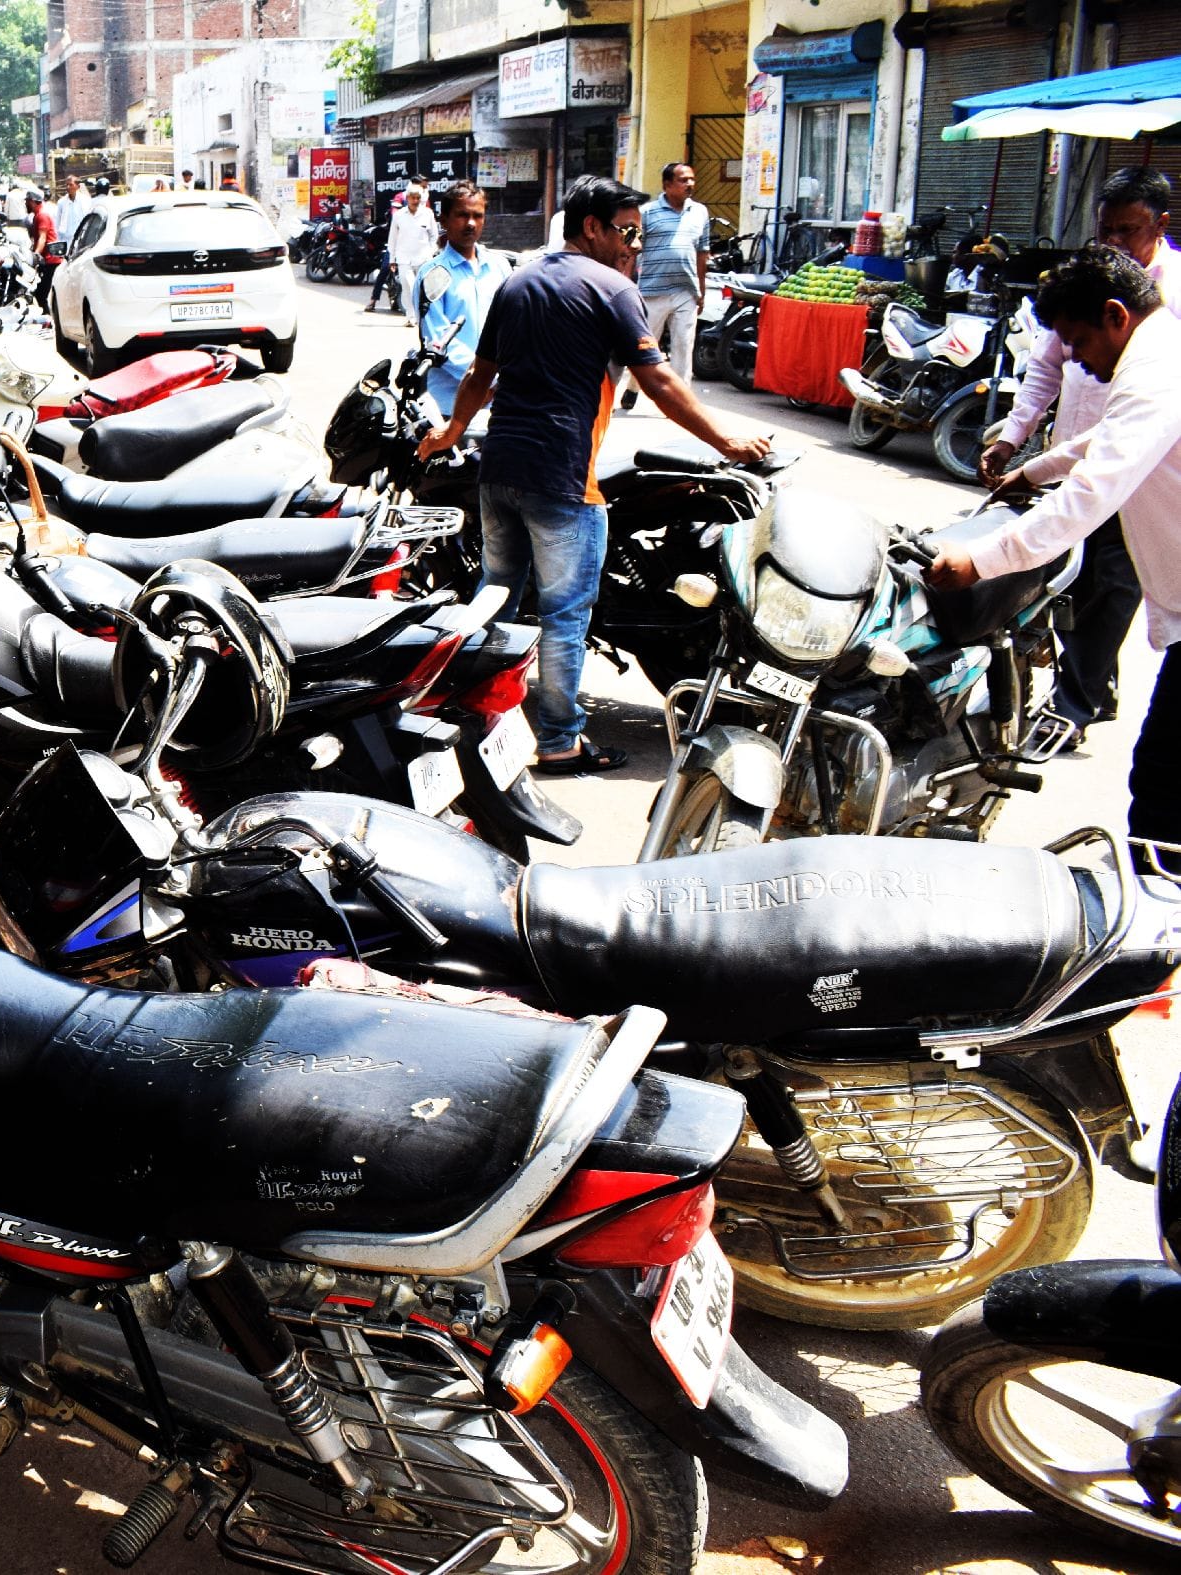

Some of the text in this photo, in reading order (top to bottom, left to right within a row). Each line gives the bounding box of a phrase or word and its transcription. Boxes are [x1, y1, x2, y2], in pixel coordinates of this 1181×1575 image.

[572, 78, 595, 99] बीज
[312, 159, 349, 179] अनिल
[249, 926, 314, 940] HERO
[230, 933, 336, 951] HONDA
[820, 1001, 857, 1013] SPEED
[321, 1168, 363, 1183] Royal
[295, 1202, 335, 1211] POLO
